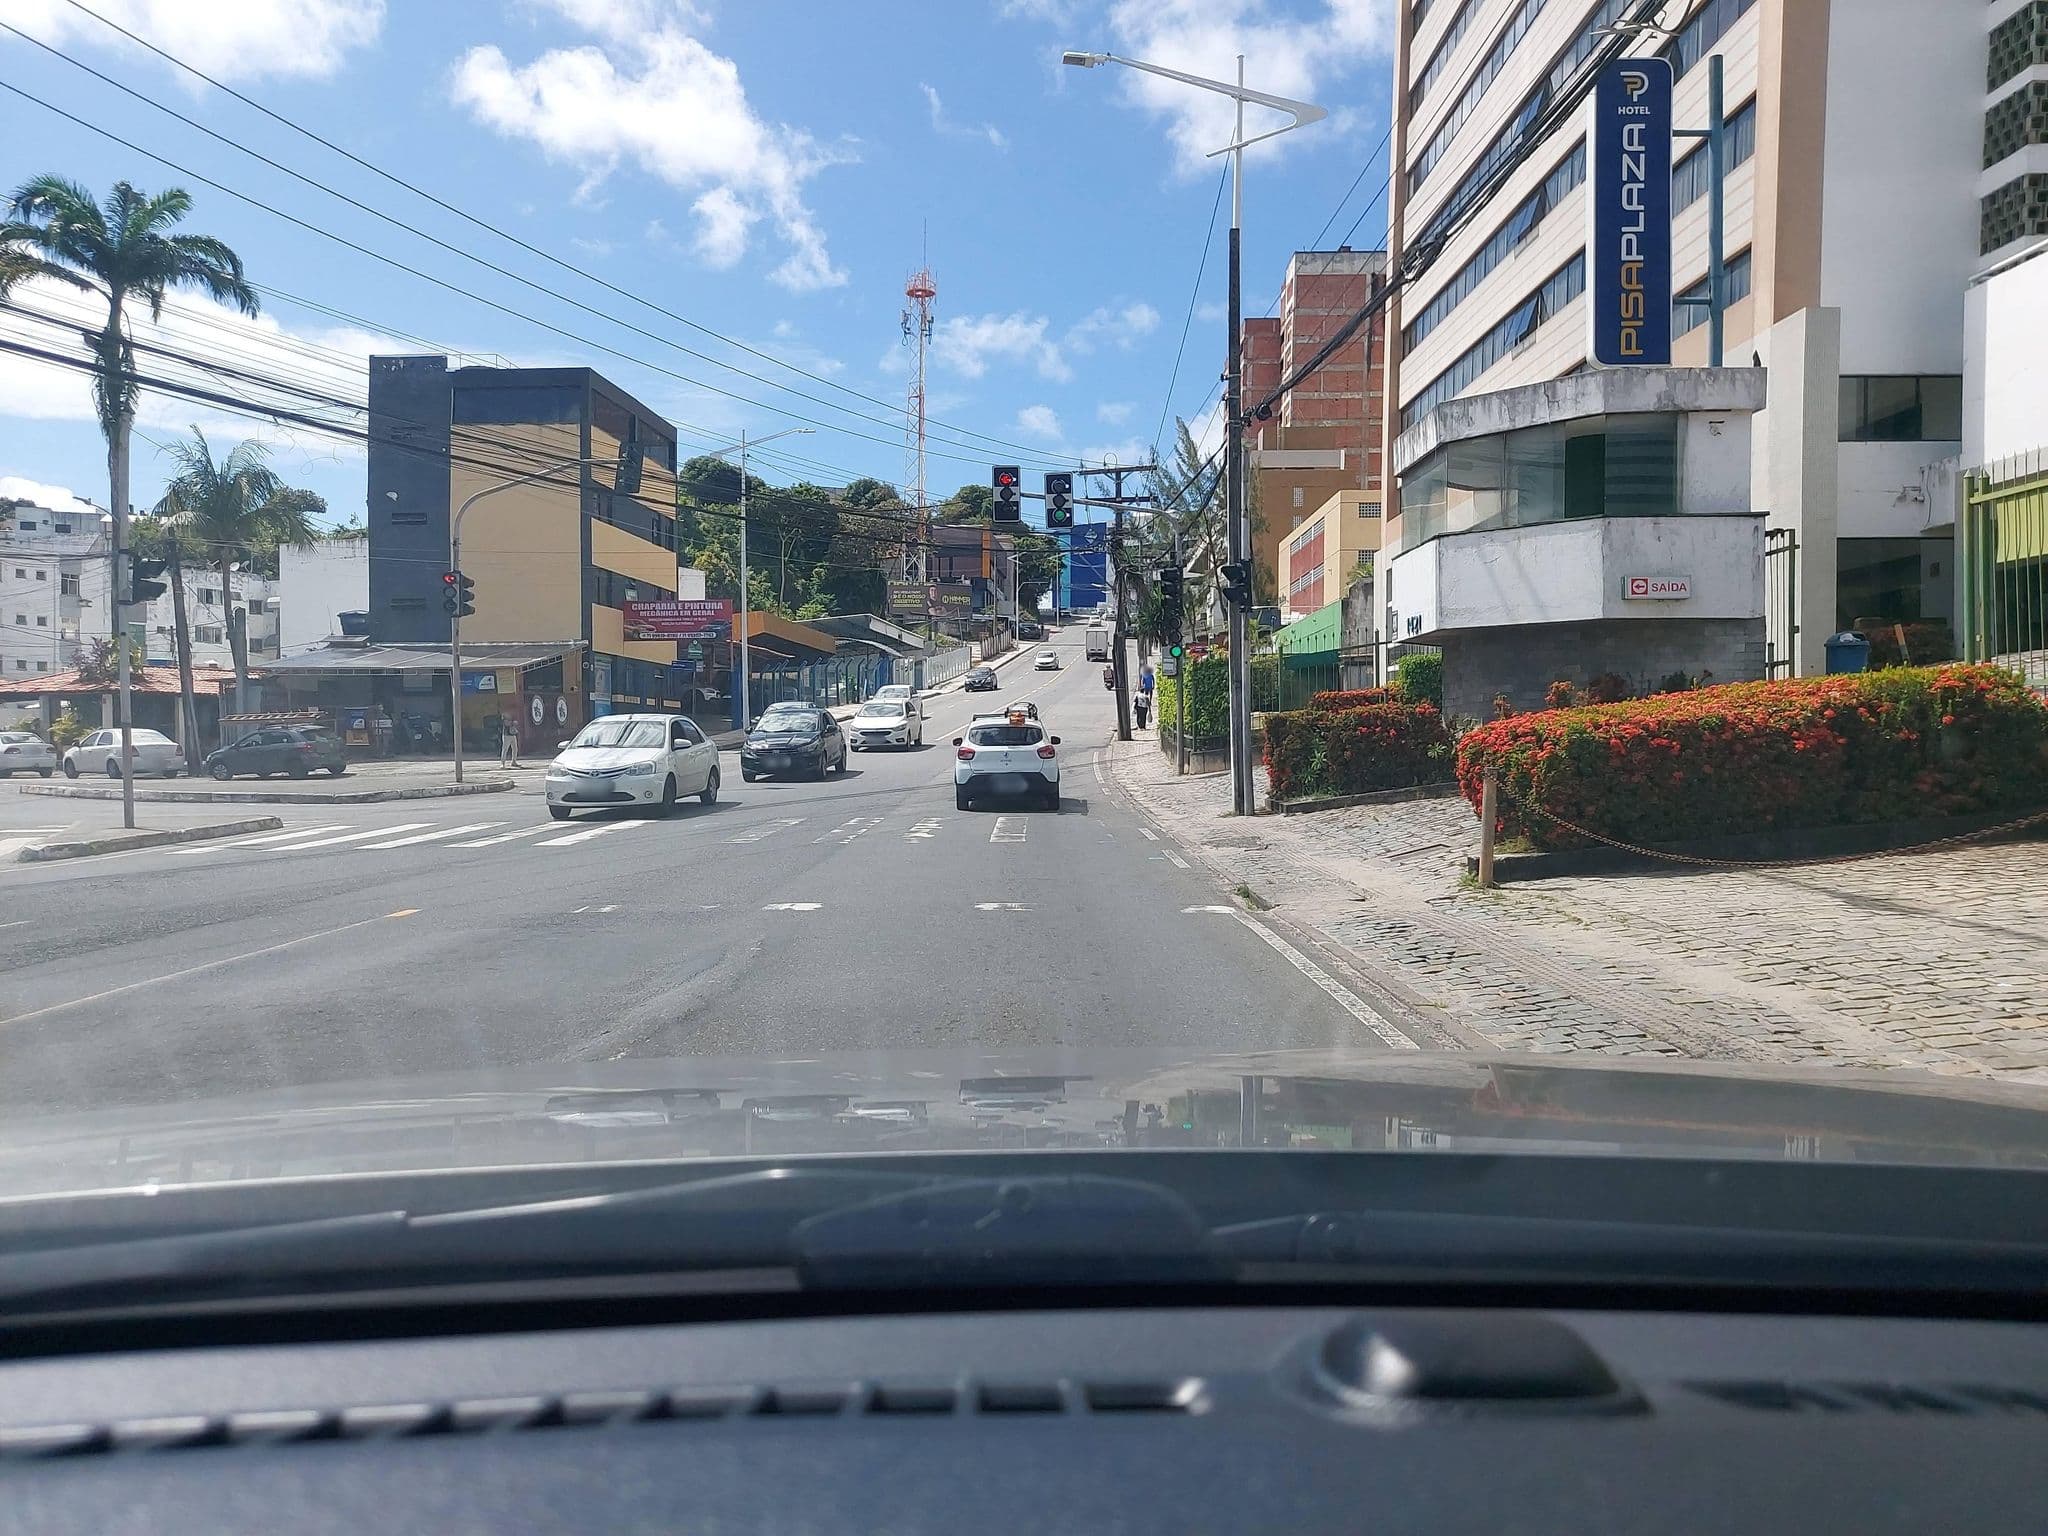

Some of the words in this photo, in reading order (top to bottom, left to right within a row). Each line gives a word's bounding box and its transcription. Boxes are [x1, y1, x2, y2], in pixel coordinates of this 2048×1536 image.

[1617, 106, 1651, 115] HOTEL
[1651, 580, 1687, 592] SAÍDA
[631, 602, 677, 611] CHAPARIA
[684, 602, 723, 610] PINTURA
